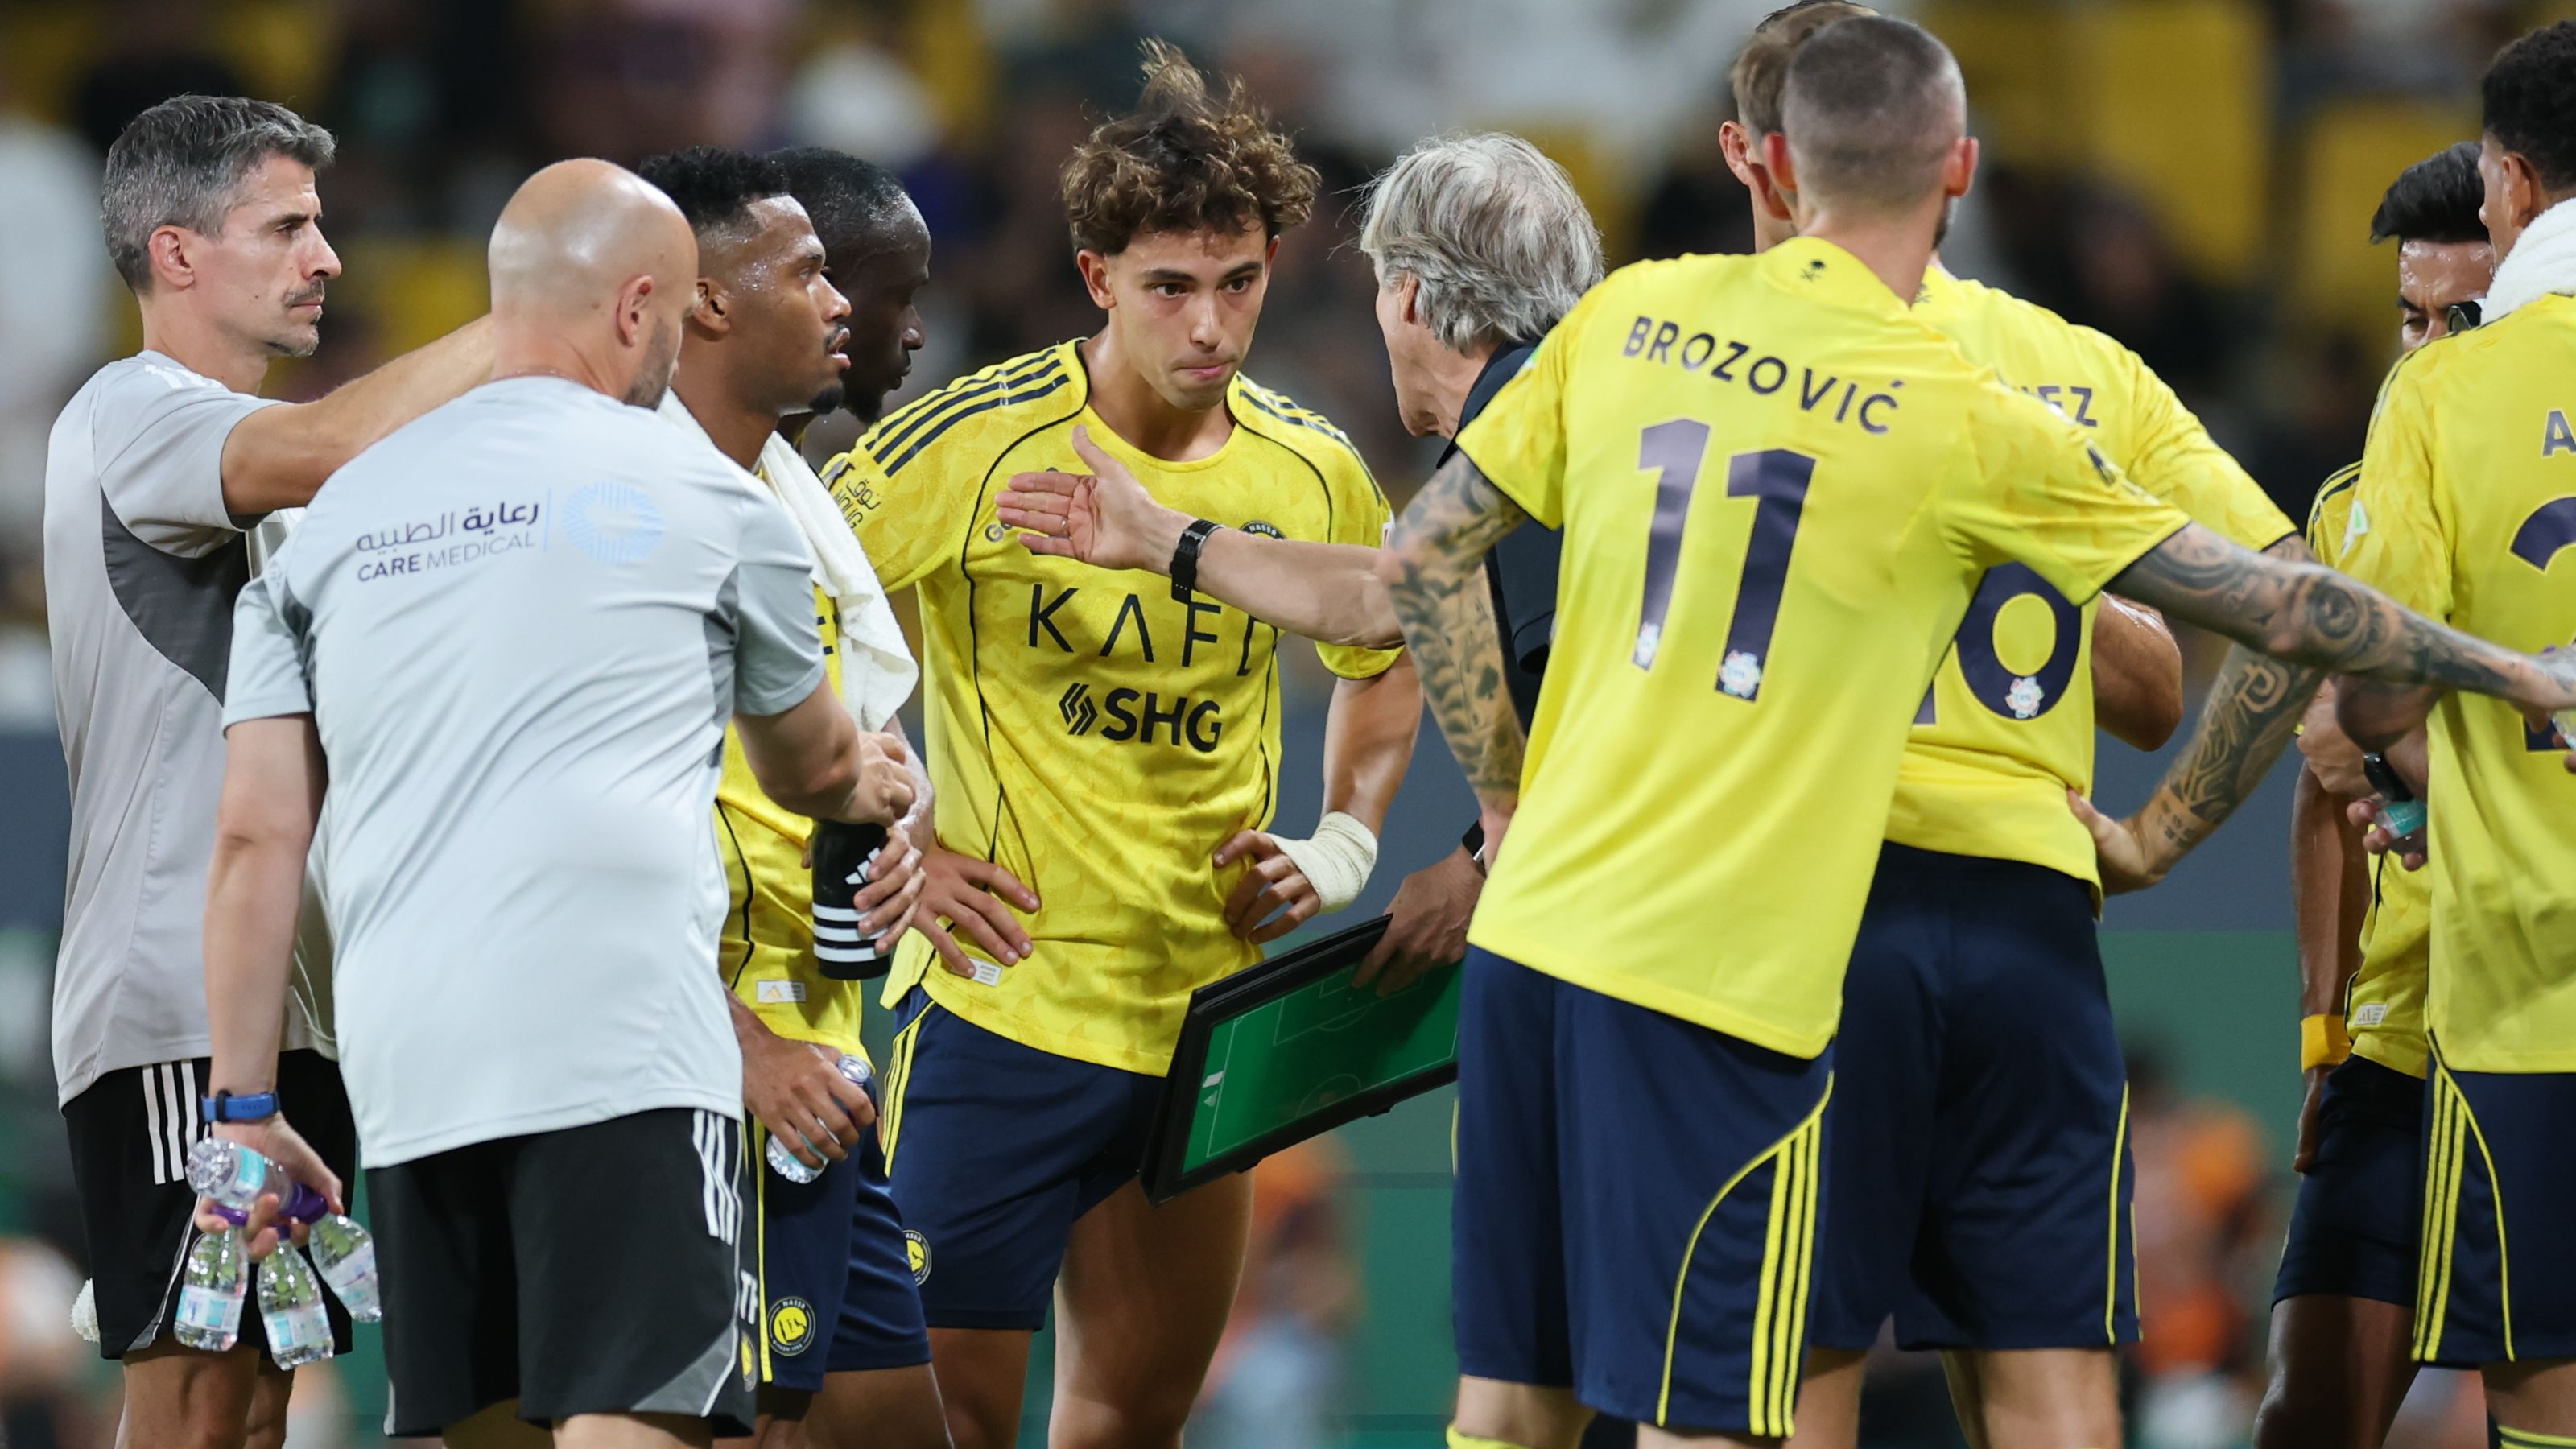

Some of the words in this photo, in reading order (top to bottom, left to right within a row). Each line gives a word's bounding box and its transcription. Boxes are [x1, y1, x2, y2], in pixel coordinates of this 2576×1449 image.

[1624, 314, 1905, 436] BROZOVIĆ
[2021, 386, 2098, 427] EZ
[462, 502, 539, 535] رعاية
[357, 555, 421, 582] CARE
[426, 532, 535, 570] MEDICAL
[1631, 418, 1817, 702] 11
[1101, 687, 1222, 752] SHG
[782, 1299, 806, 1310] NASSR
